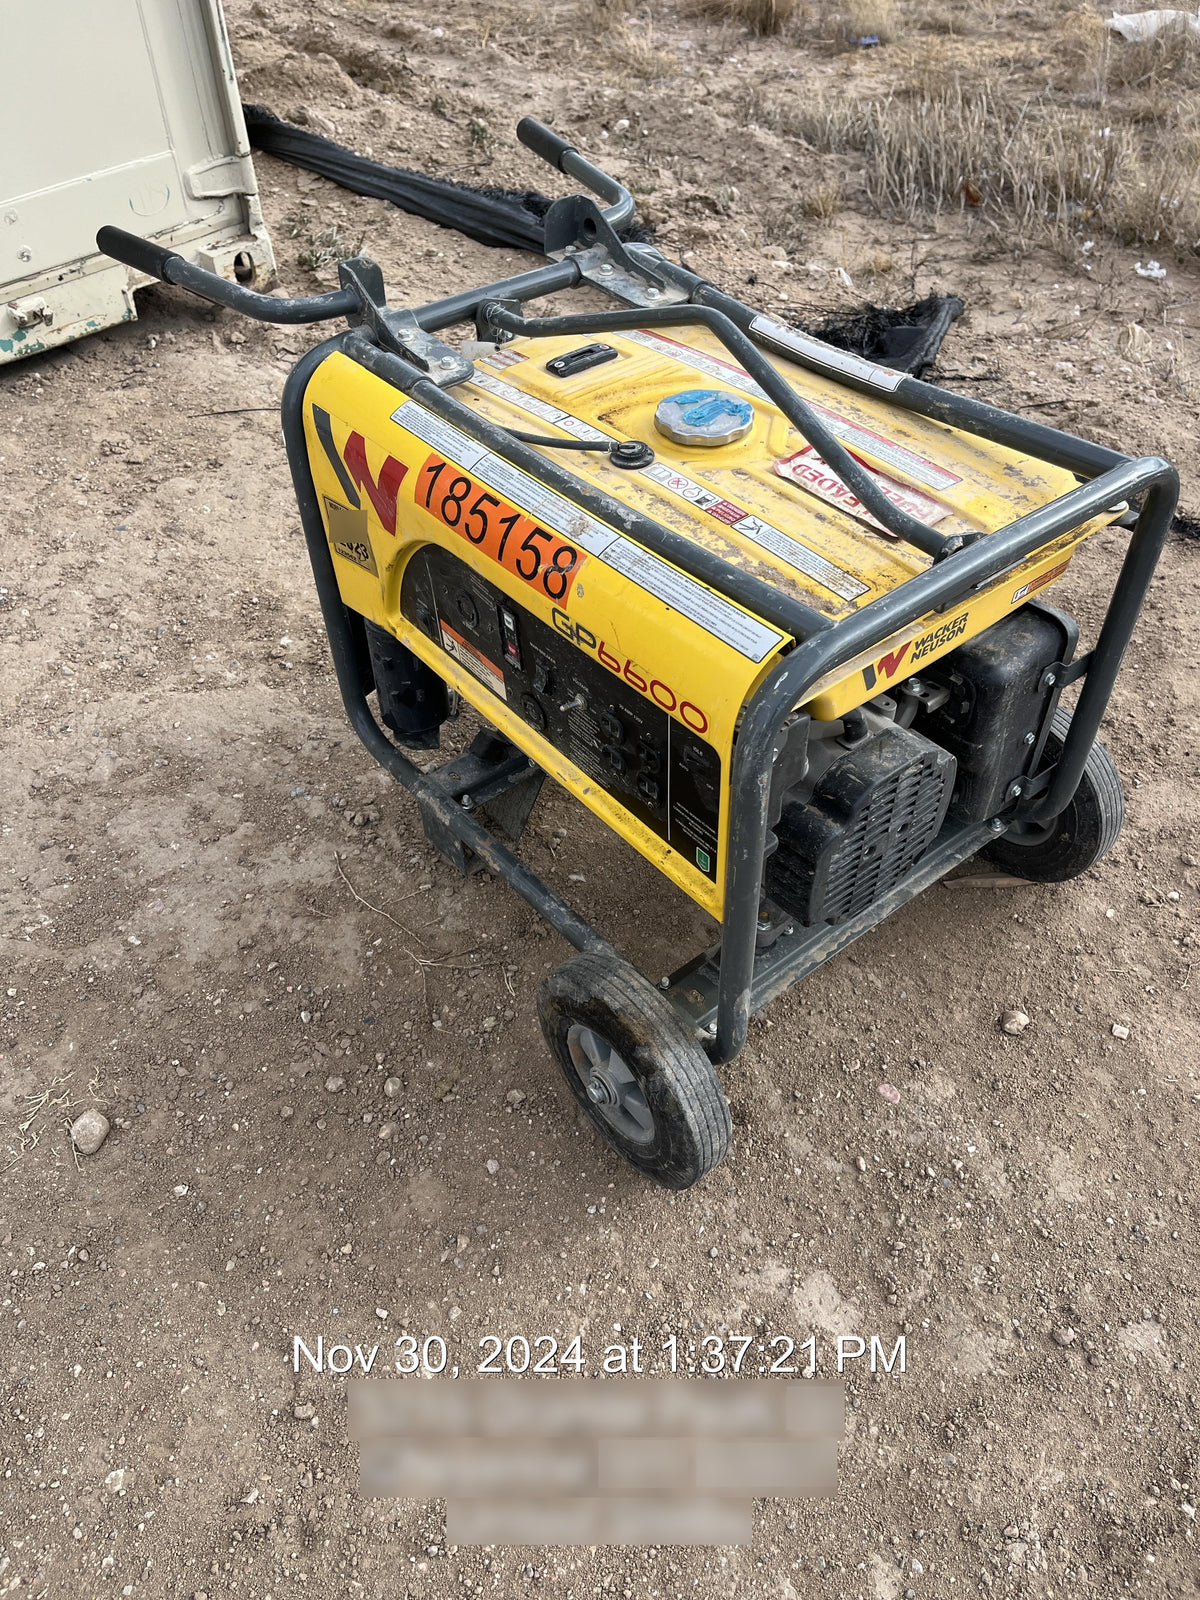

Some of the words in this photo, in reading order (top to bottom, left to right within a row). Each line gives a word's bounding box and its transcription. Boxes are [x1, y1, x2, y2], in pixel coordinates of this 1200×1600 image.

[425, 462, 577, 600] 185158
[551, 607, 709, 734] GP6600
[910, 623, 967, 664] NEUSON
[915, 612, 969, 651] WACKER
